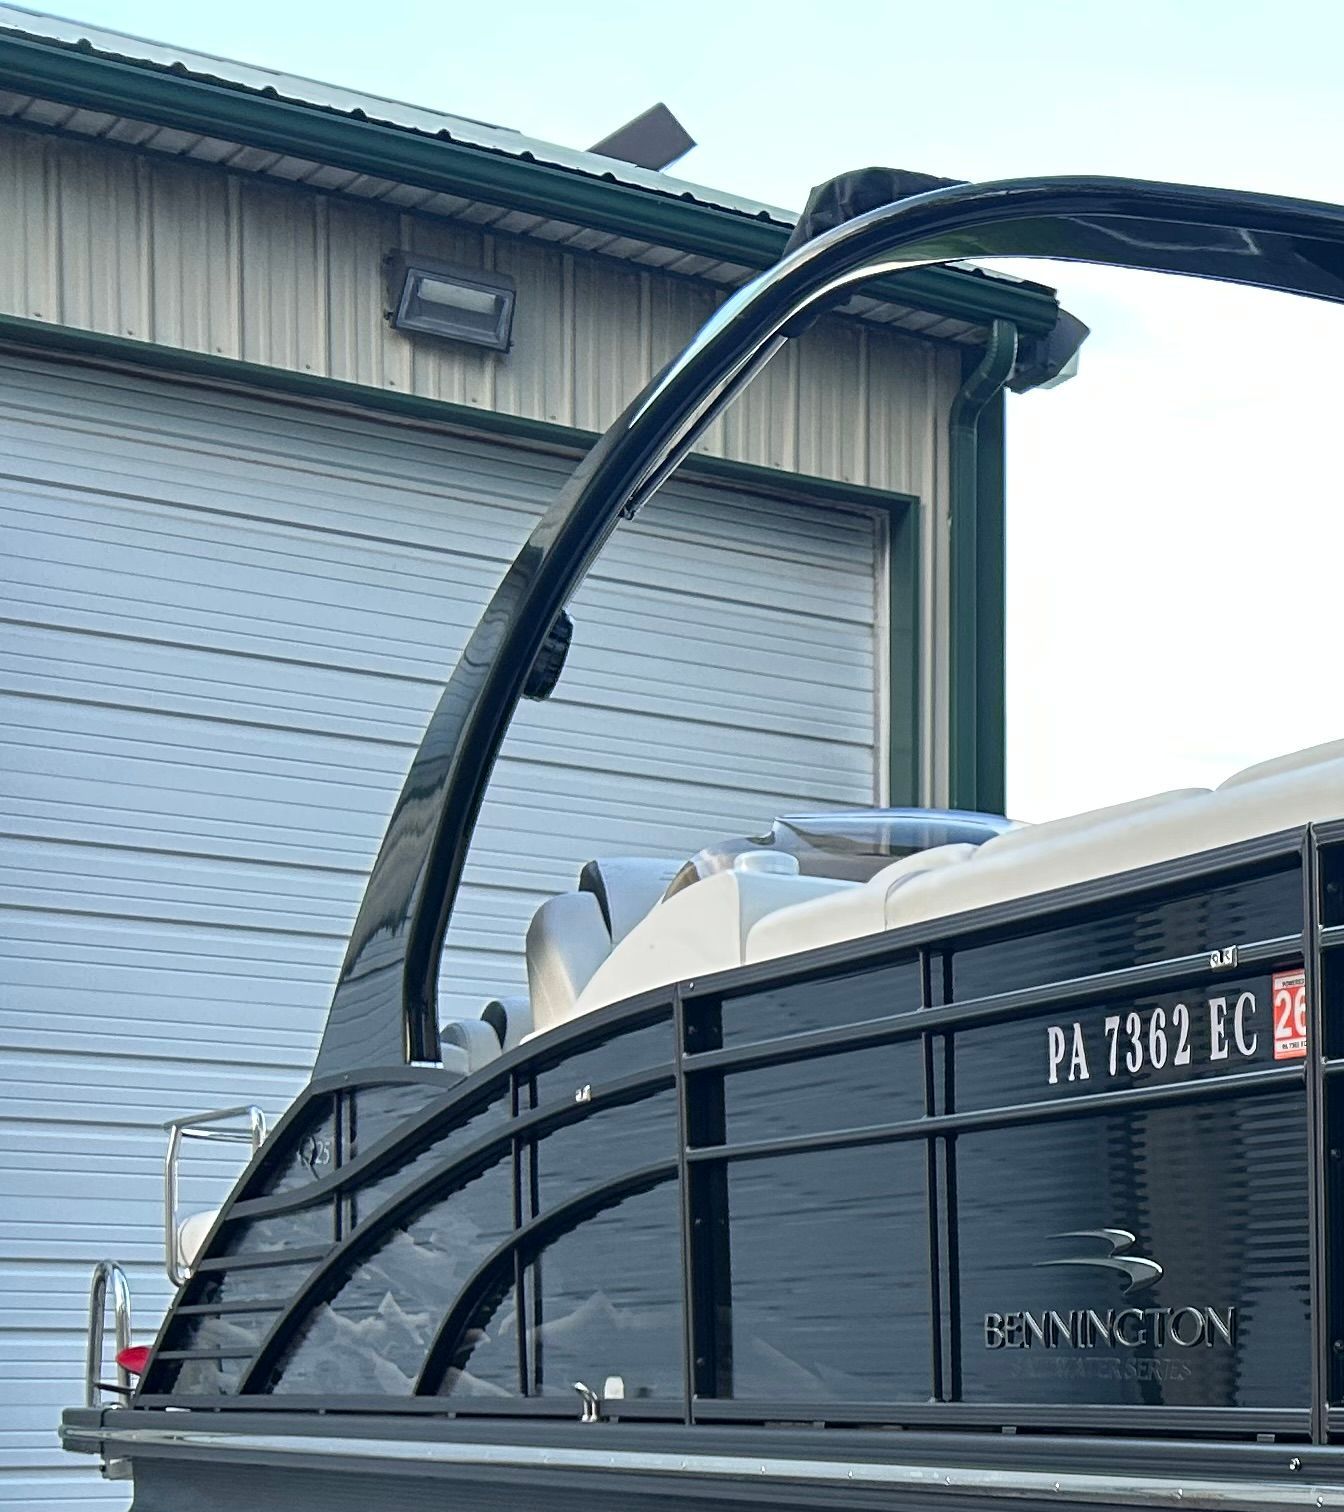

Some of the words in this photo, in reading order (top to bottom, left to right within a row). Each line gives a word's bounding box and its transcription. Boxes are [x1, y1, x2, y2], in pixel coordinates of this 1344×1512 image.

[1047, 1022, 1090, 1084] PA
[1104, 1003, 1192, 1076] 7362
[1208, 991, 1258, 1061] EC
[984, 1306, 1236, 1350] BENNINGTON
